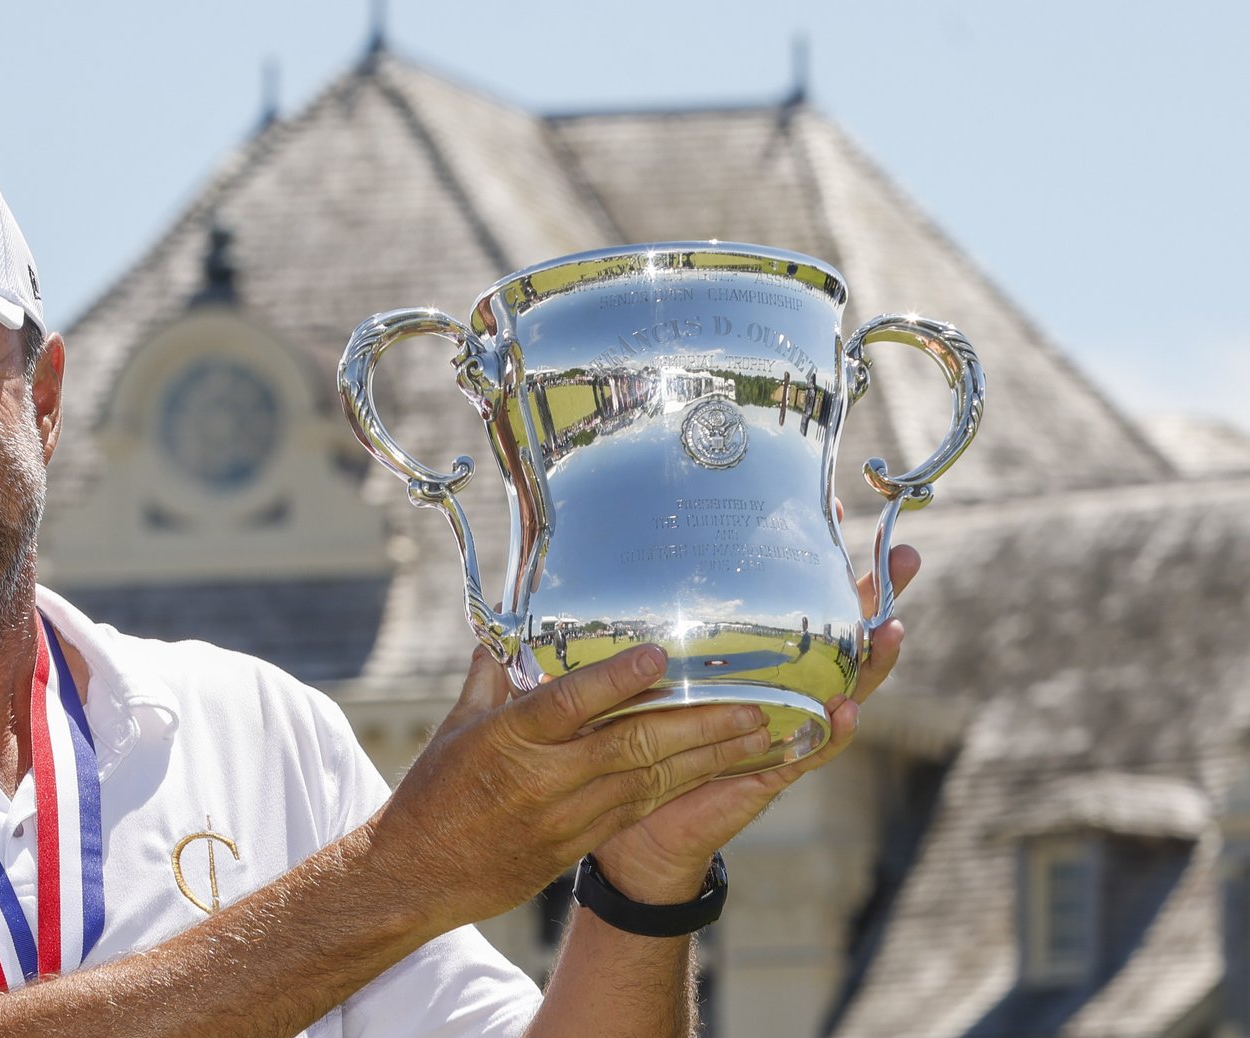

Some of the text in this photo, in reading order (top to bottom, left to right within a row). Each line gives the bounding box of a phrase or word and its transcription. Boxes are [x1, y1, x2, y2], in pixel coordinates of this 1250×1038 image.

[706, 287, 804, 312] CHAMPIONSHIP
[589, 315, 703, 379] FRANCIS
[724, 354, 777, 373] TROPHY
[676, 498, 766, 512] PRESENTED BY
[652, 514, 680, 530] THE
[686, 514, 751, 529] COUNTRY
